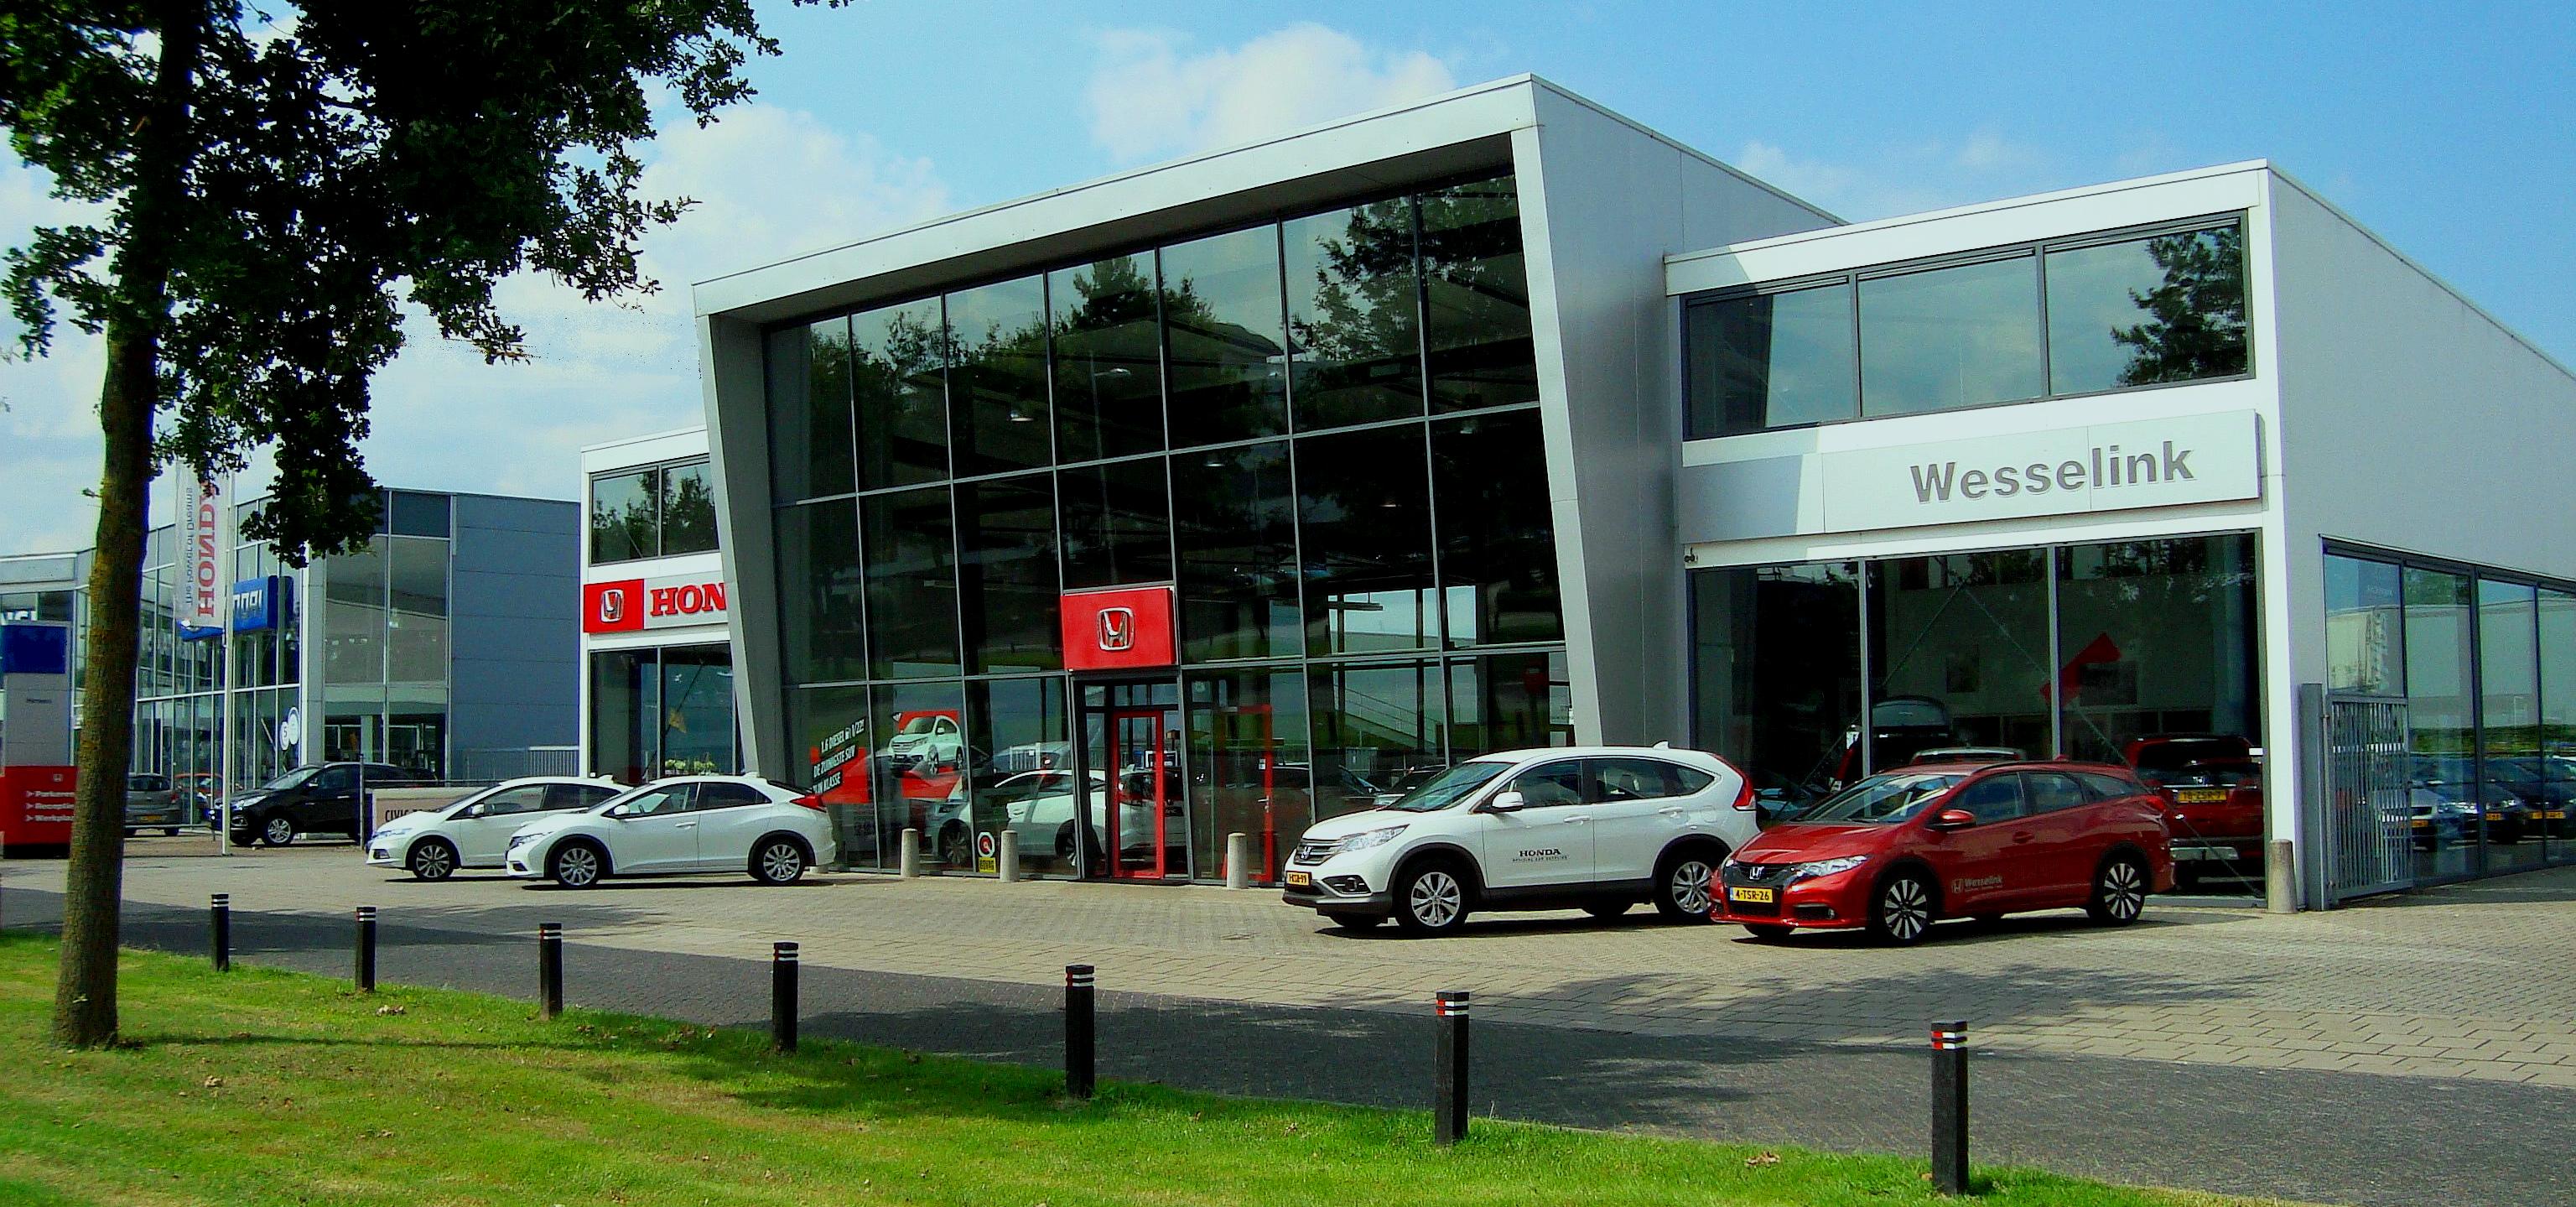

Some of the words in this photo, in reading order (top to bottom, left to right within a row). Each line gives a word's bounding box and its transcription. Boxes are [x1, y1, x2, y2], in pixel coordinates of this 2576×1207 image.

[1909, 440, 2194, 504] Wesselink
[650, 582, 727, 617] HON
[1519, 849, 1561, 857] HONDA
[1736, 889, 1769, 901] 4-TSR-26
